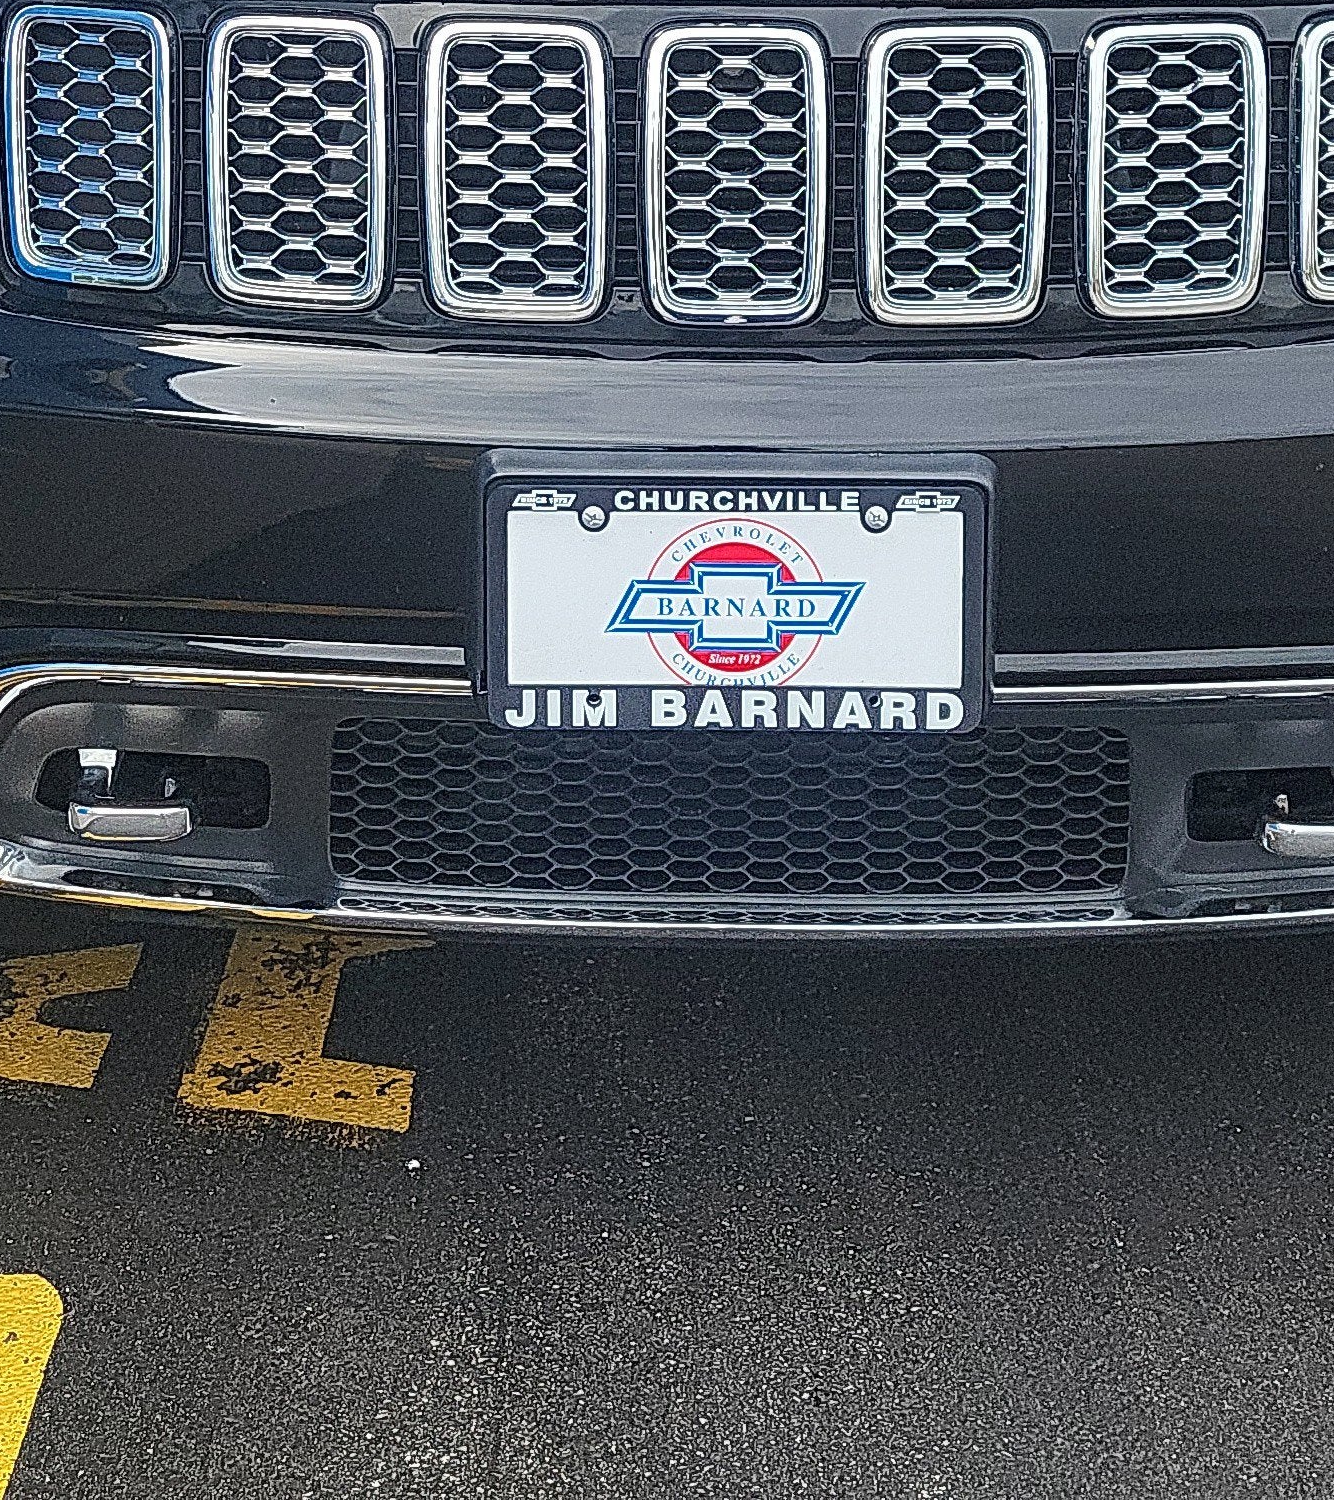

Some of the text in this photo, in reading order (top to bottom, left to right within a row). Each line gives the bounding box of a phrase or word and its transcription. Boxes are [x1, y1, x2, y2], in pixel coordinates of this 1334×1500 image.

[613, 490, 860, 511] CHURCHVILLE
[671, 525, 804, 564] CHEVROLET
[657, 597, 816, 618] BARNARD
[708, 653, 762, 665] Since 1972
[504, 689, 965, 731] JIM BARNARD
